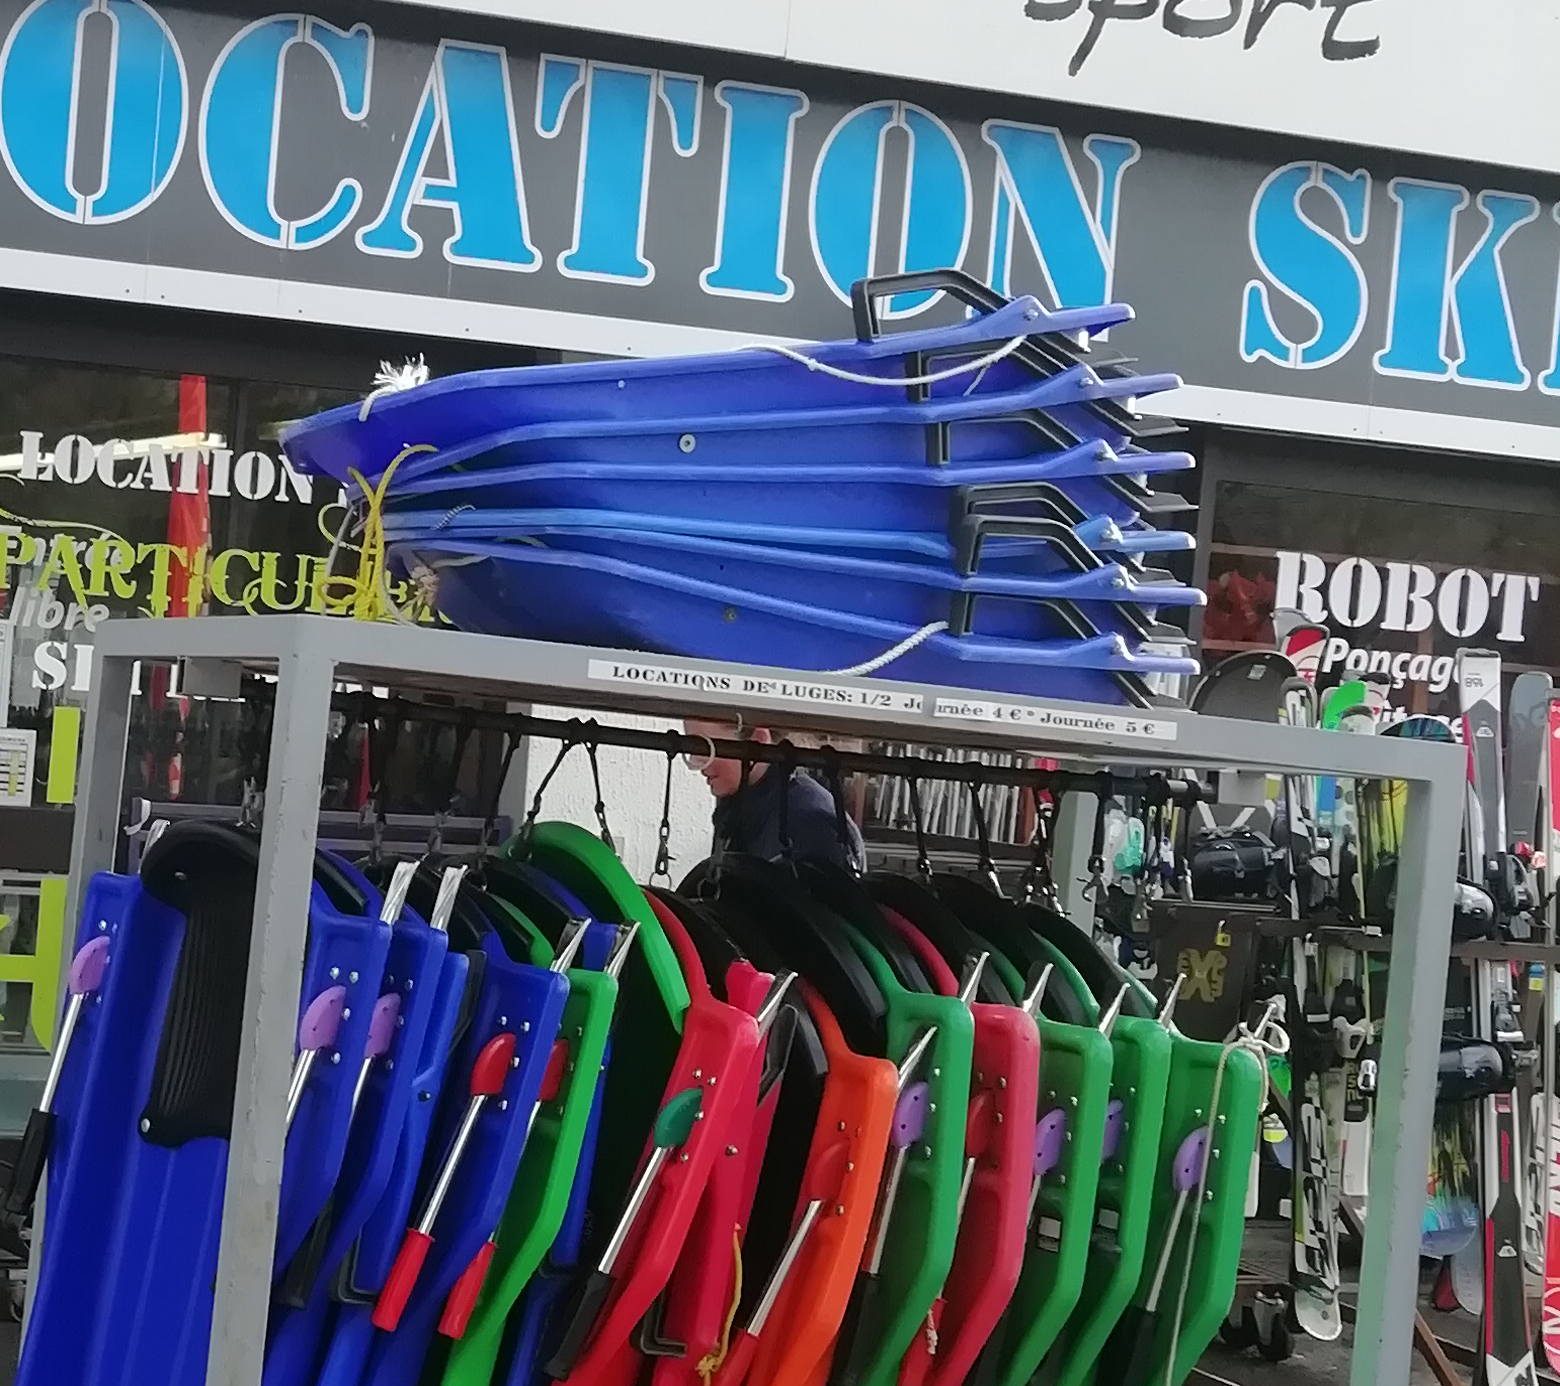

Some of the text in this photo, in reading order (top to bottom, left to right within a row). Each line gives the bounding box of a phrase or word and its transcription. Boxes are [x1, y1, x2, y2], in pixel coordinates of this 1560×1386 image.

[1240, 160, 1560, 395] SK
[17, 430, 313, 504] LOCATION
[1272, 550, 1540, 642] ROBOT
[612, 665, 731, 690] LOCATIONS
[743, 679, 769, 693] DE
[781, 683, 853, 702] LUGES:
[860, 691, 891, 706] 1/2
[1040, 711, 1115, 732] Journée
